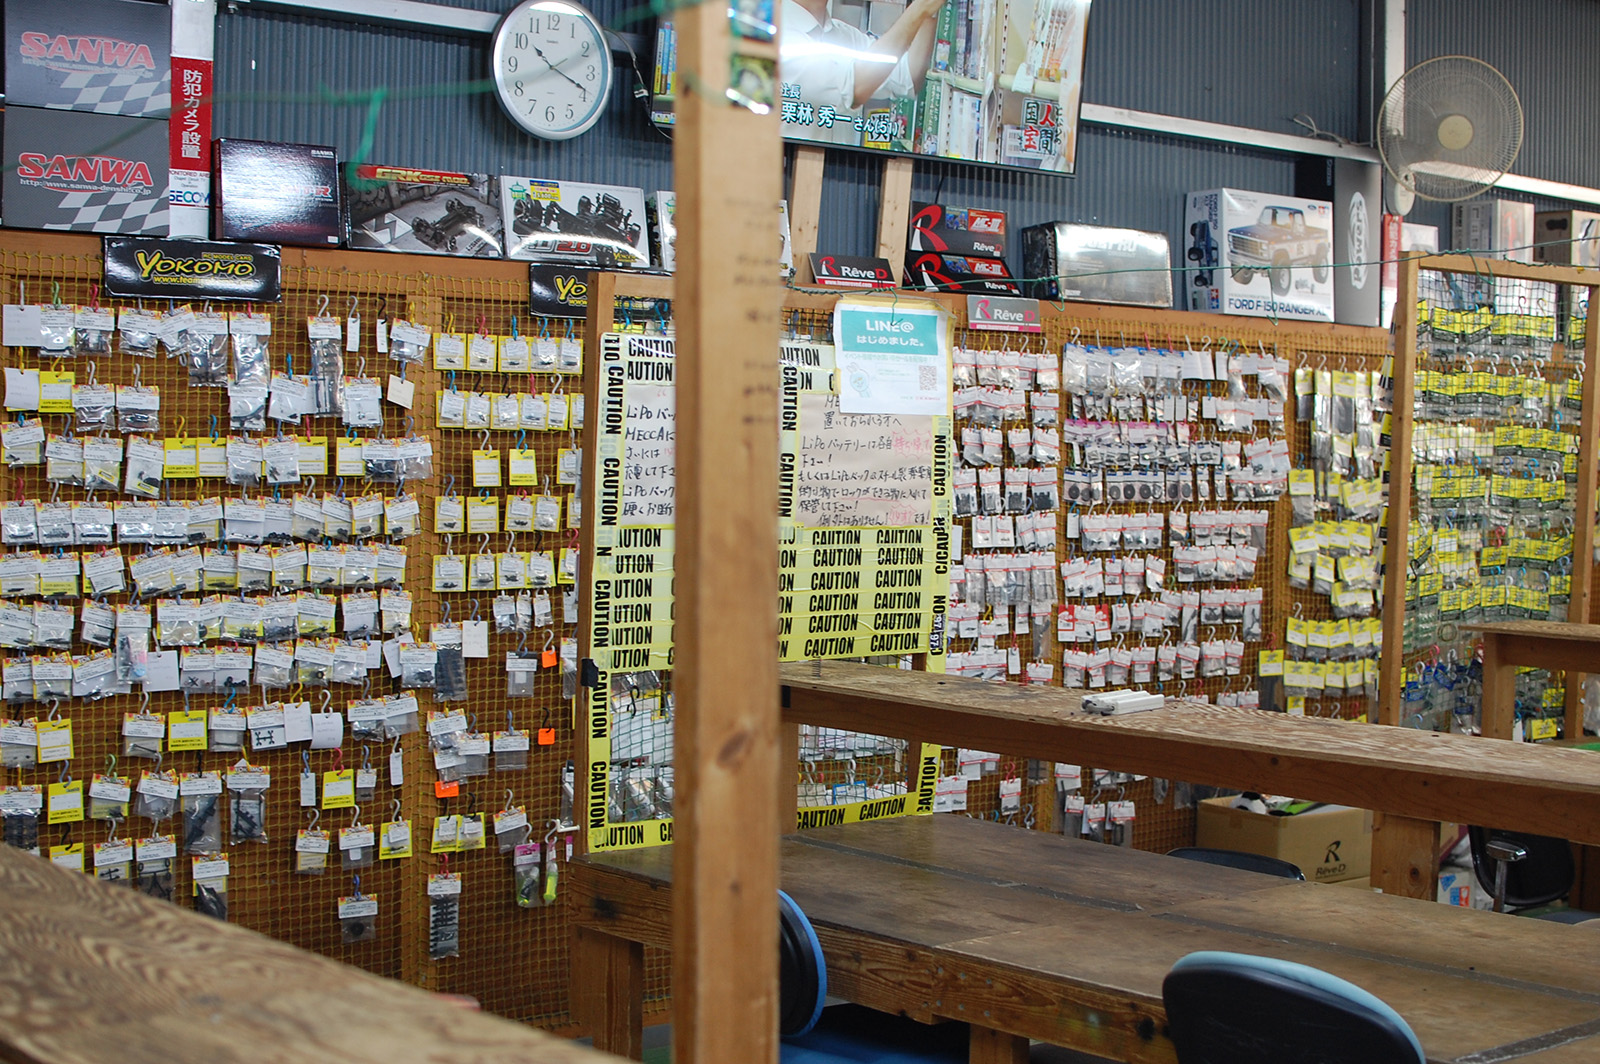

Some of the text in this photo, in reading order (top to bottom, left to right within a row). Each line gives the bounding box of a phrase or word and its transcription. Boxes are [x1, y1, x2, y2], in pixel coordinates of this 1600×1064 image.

[529, 17, 540, 34] 11
[547, 14, 560, 31] 12
[570, 23, 576, 39] 1
[20, 31, 156, 70] SANWA
[515, 33, 528, 49] 10
[581, 41, 590, 58] 2
[508, 56, 518, 73] 9
[586, 65, 595, 82] 3
[514, 80, 524, 97] 8
[182, 69, 203, 159] 防犯カメラ設置
[528, 99, 537, 115] 7
[545, 106, 555, 122] 6
[565, 104, 574, 119] 5
[781, 101, 814, 126] 栗林
[817, 105, 852, 129] 秀一
[17, 152, 154, 187] SANWA
[169, 170, 197, 178] ONITORED
[136, 251, 254, 279] YOKOMO
[840, 265, 888, 280] RêveD
[993, 308, 1036, 322] RêveD
[1228, 298, 1255, 311] FORD
[1279, 303, 1315, 315] RANGER
[628, 337, 675, 358] CAUTIO
[856, 335, 924, 347] はじめました。
[627, 360, 673, 381] AUTION
[605, 366, 625, 434] CAUTION
[782, 366, 798, 431] CAUTION
[933, 434, 947, 497] CAUTION
[601, 457, 620, 526] CAUTION
[778, 452, 796, 518] CAUTION
[617, 528, 662, 548] UTION
[812, 530, 861, 546] CAUTION
[876, 529, 922, 544] CAUTION
[813, 549, 862, 567] CAUTION
[877, 548, 923, 565] CAUTION
[614, 578, 652, 599] UTION
[811, 571, 860, 591] CAUTION
[875, 569, 921, 588] CAUTION
[809, 593, 858, 612] CAUTION
[874, 592, 921, 610] CAUTION
[593, 580, 611, 648] CAUTION
[808, 613, 858, 633] CAUTION
[873, 613, 921, 631] CAUTION
[612, 626, 652, 646] UTION
[870, 632, 919, 652] CAUTION
[804, 637, 854, 657] CAUTION
[611, 648, 650, 669] UTION
[592, 671, 608, 739] CAUTION
[590, 761, 606, 828] CAUTION
[859, 797, 906, 821] CAUTION
[594, 825, 644, 848] AUTION
